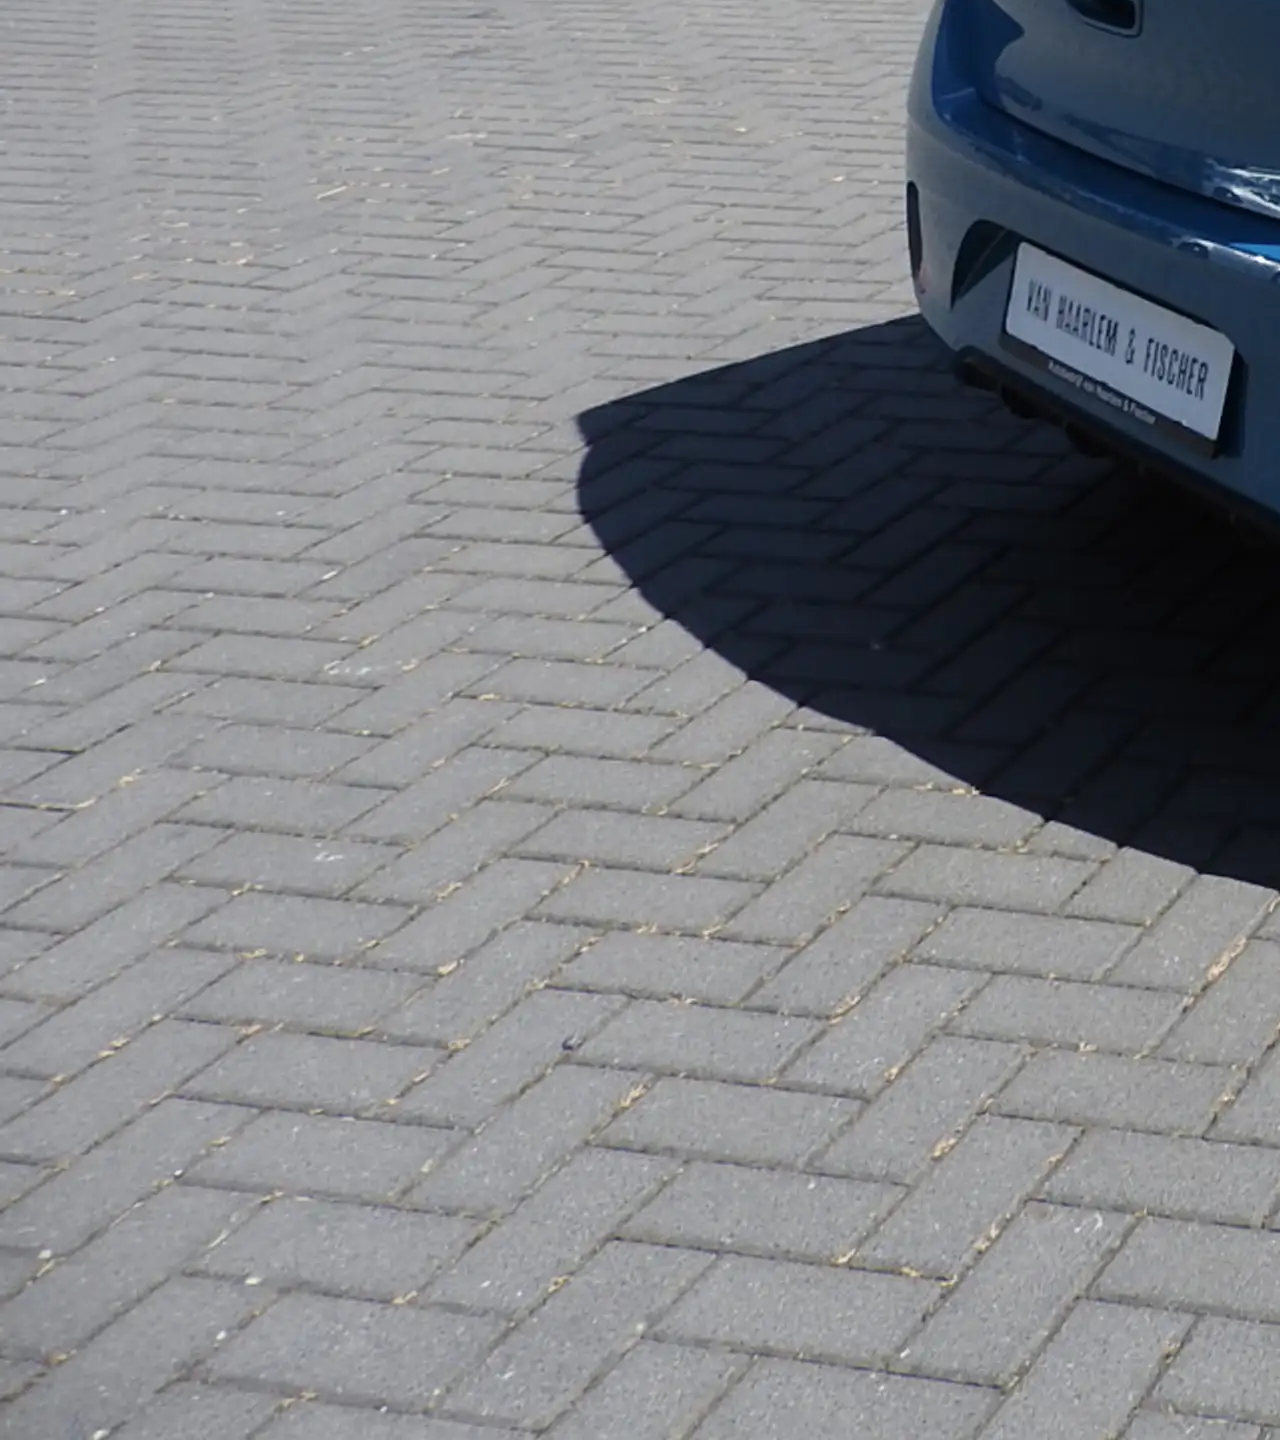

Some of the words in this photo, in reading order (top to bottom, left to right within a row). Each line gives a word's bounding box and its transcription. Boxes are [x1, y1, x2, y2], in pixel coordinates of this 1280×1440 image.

[1025, 278, 1053, 324] VAN
[1055, 294, 1120, 357] HAARLEM
[1124, 327, 1137, 366] &
[1143, 336, 1210, 402] FISCHER
